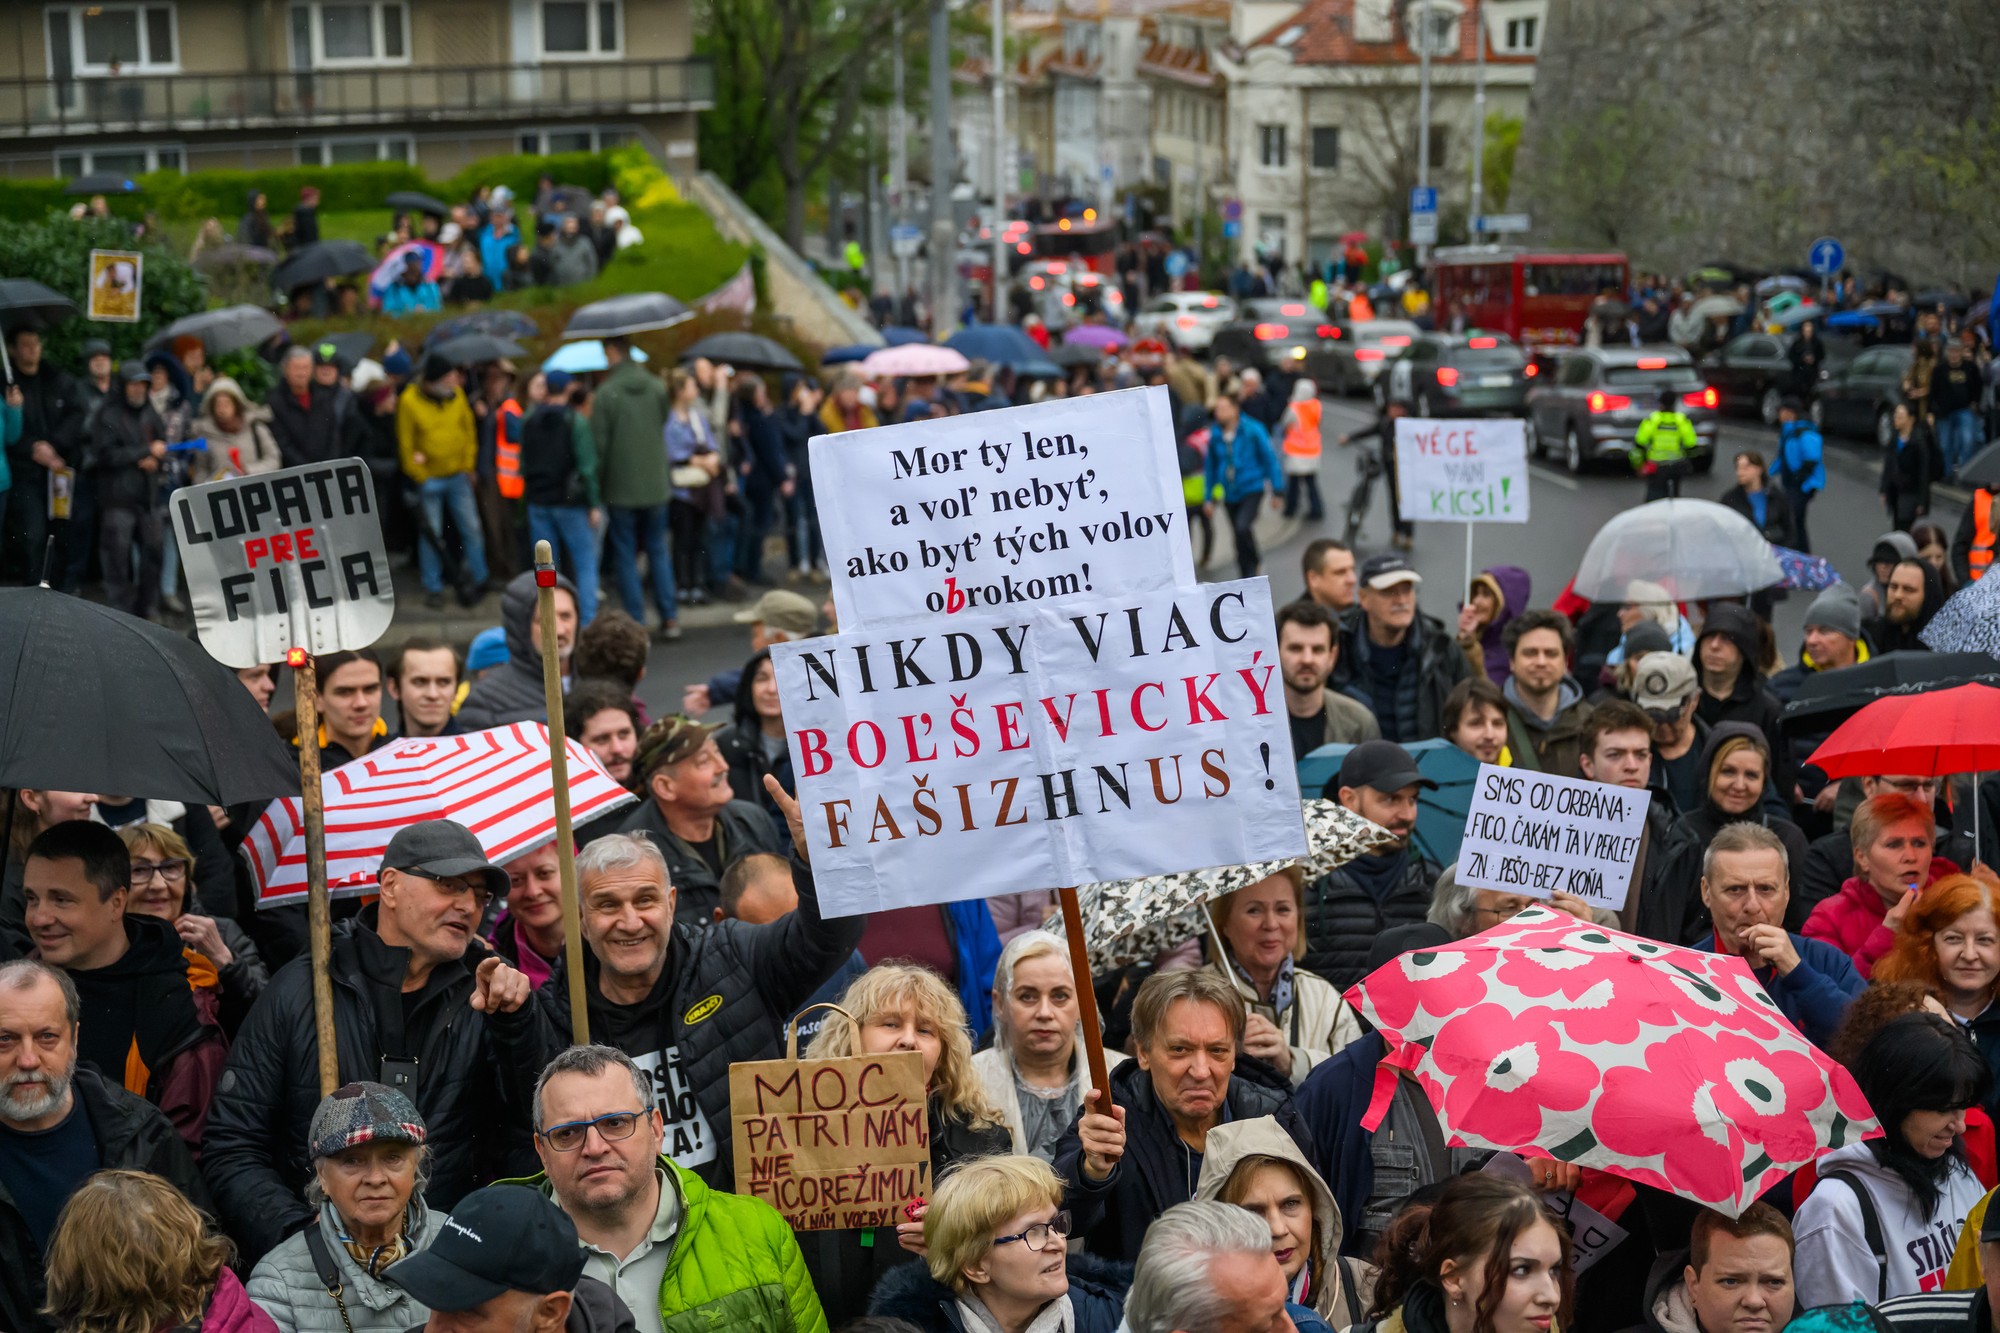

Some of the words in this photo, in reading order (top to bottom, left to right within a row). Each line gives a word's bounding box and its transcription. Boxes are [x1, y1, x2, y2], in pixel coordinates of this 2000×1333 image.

[890, 446, 967, 480] Mor
[978, 439, 1012, 473] ty
[1022, 431, 1088, 460] len,
[178, 465, 370, 545] LOPATA
[890, 504, 910, 526] a
[918, 486, 978, 522] voľ
[990, 469, 1108, 512] nebyť,
[244, 528, 319, 569] PRE
[846, 547, 909, 578] ako
[918, 532, 982, 573] byť
[993, 522, 1070, 565] tých
[1079, 510, 1174, 546] volov
[221, 551, 379, 622] FICA
[925, 563, 1094, 614] obrokom!
[798, 624, 1031, 701] NIKDY
[1069, 590, 1249, 664] VIAC
[793, 650, 1276, 778] BOĽŠEVICKÝ
[1484, 774, 1525, 805] SMS
[1530, 782, 1554, 811] OD
[1556, 787, 1632, 822] ORBÁNA:
[1511, 815, 1561, 852] ČAKÁM
[1565, 824, 1579, 856] ŤA
[1583, 831, 1595, 856] V
[742, 1101, 861, 1153] PATRÍ
[864, 1098, 927, 1148] NÁM,
[751, 1153, 794, 1181] NIE
[809, 1207, 836, 1229] NÁM
